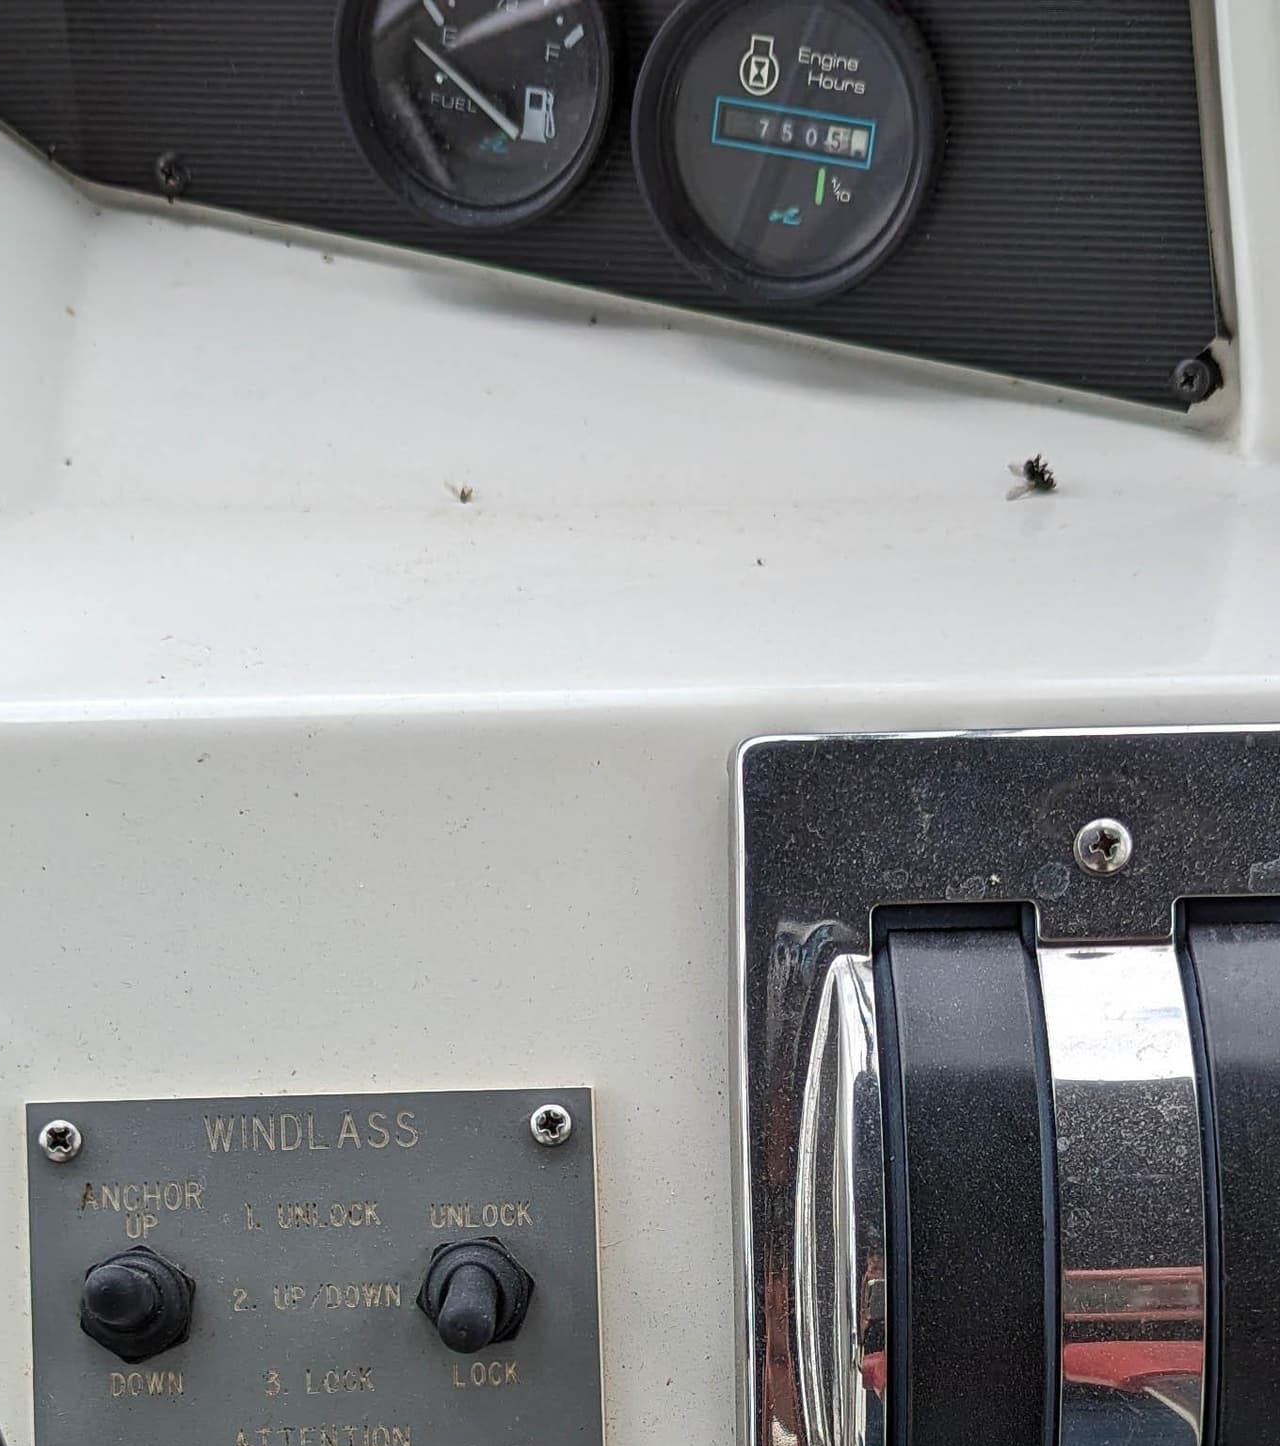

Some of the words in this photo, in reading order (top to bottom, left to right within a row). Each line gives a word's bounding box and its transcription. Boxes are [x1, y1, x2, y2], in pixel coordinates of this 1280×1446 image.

[798, 46, 860, 73] Engine
[807, 71, 867, 95] Hours
[430, 91, 478, 114] FUEL
[203, 1111, 419, 1152] WINDLASS
[80, 1181, 204, 1212] ANCHOR
[125, 1212, 160, 1239] UP
[277, 1199, 383, 1230] UNLOCK
[430, 1199, 534, 1229] UNLOCK
[110, 1370, 185, 1397] DOWN
[305, 1367, 375, 1395] LOCK
[452, 1361, 521, 1389] LOCK
